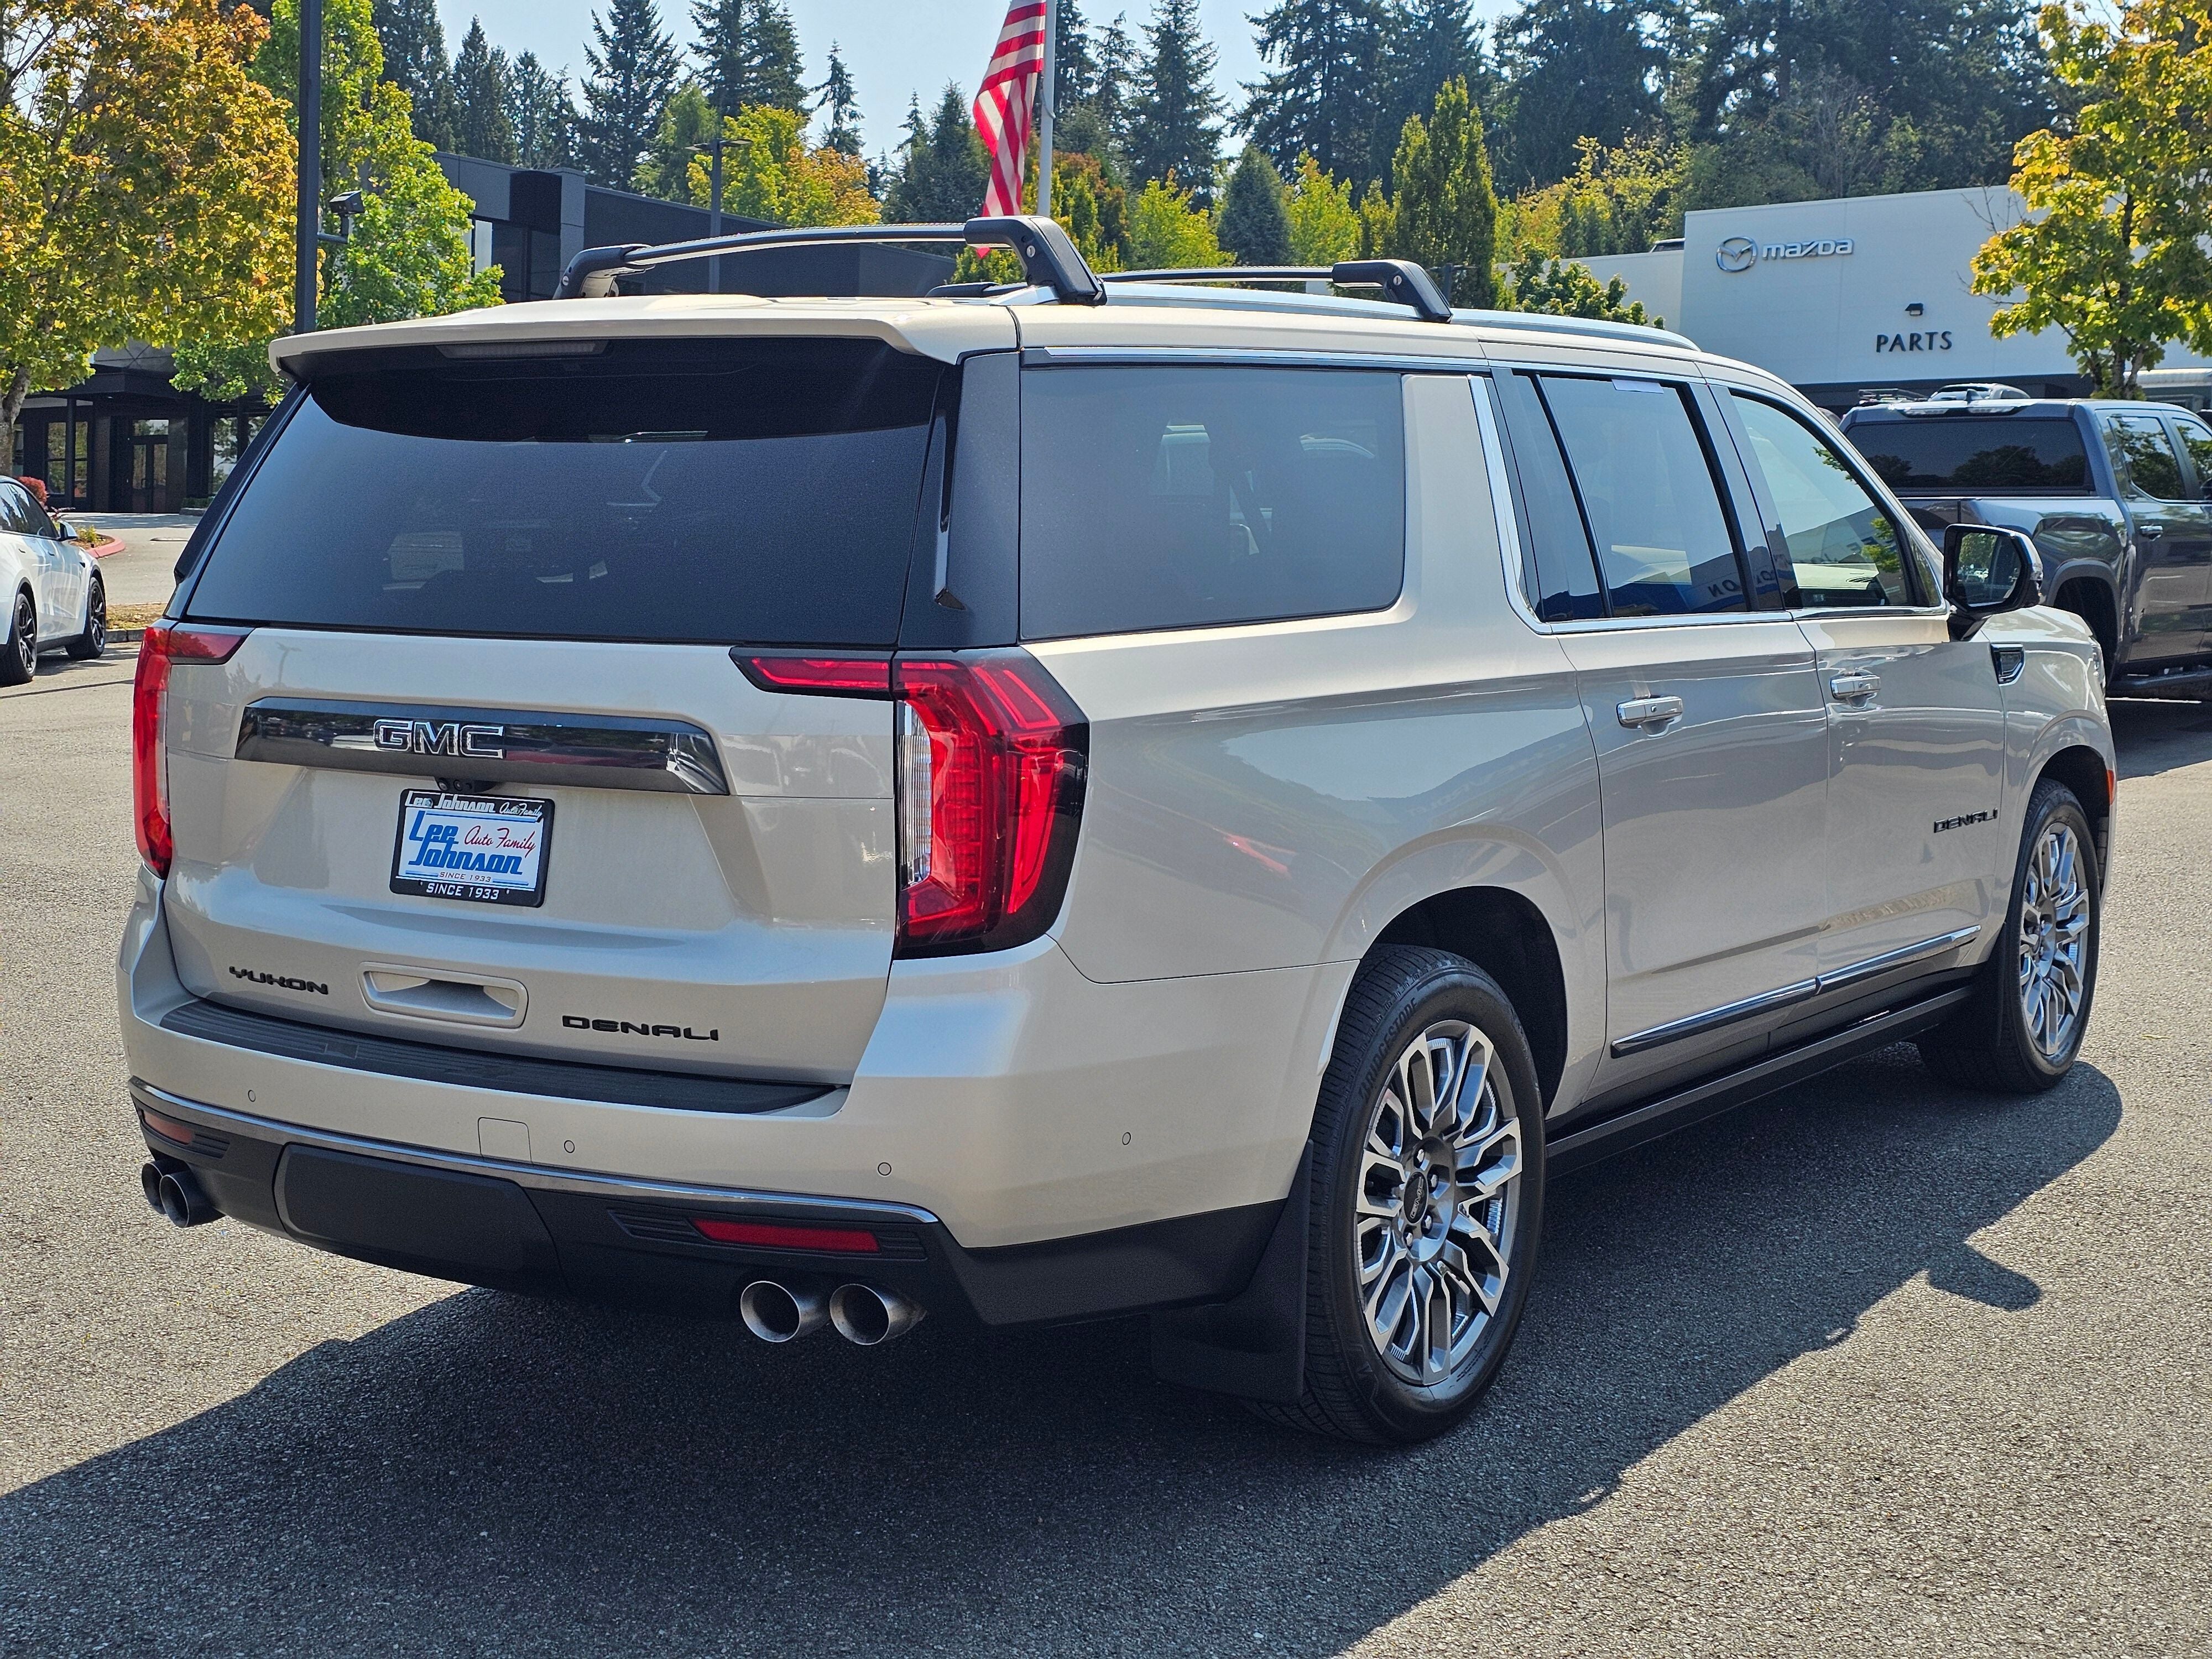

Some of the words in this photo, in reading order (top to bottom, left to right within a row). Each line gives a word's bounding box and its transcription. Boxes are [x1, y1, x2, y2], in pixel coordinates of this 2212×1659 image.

[1875, 331, 1953, 353] PARTS
[373, 719, 505, 760] GMC
[434, 794, 495, 813] Johnson
[499, 802, 520, 815] Au
[409, 811, 459, 844] Lee
[1933, 807, 1998, 833] DENALI
[464, 825, 494, 846] Auto
[495, 827, 536, 858] Family
[408, 841, 523, 875] Johnson
[470, 873, 491, 882] 1933
[426, 883, 463, 896] SINCE
[469, 887, 499, 900] 1933
[228, 966, 328, 995] YUKON
[562, 1015, 718, 1041] DENALI
[1410, 1176, 1424, 1219] GMC
